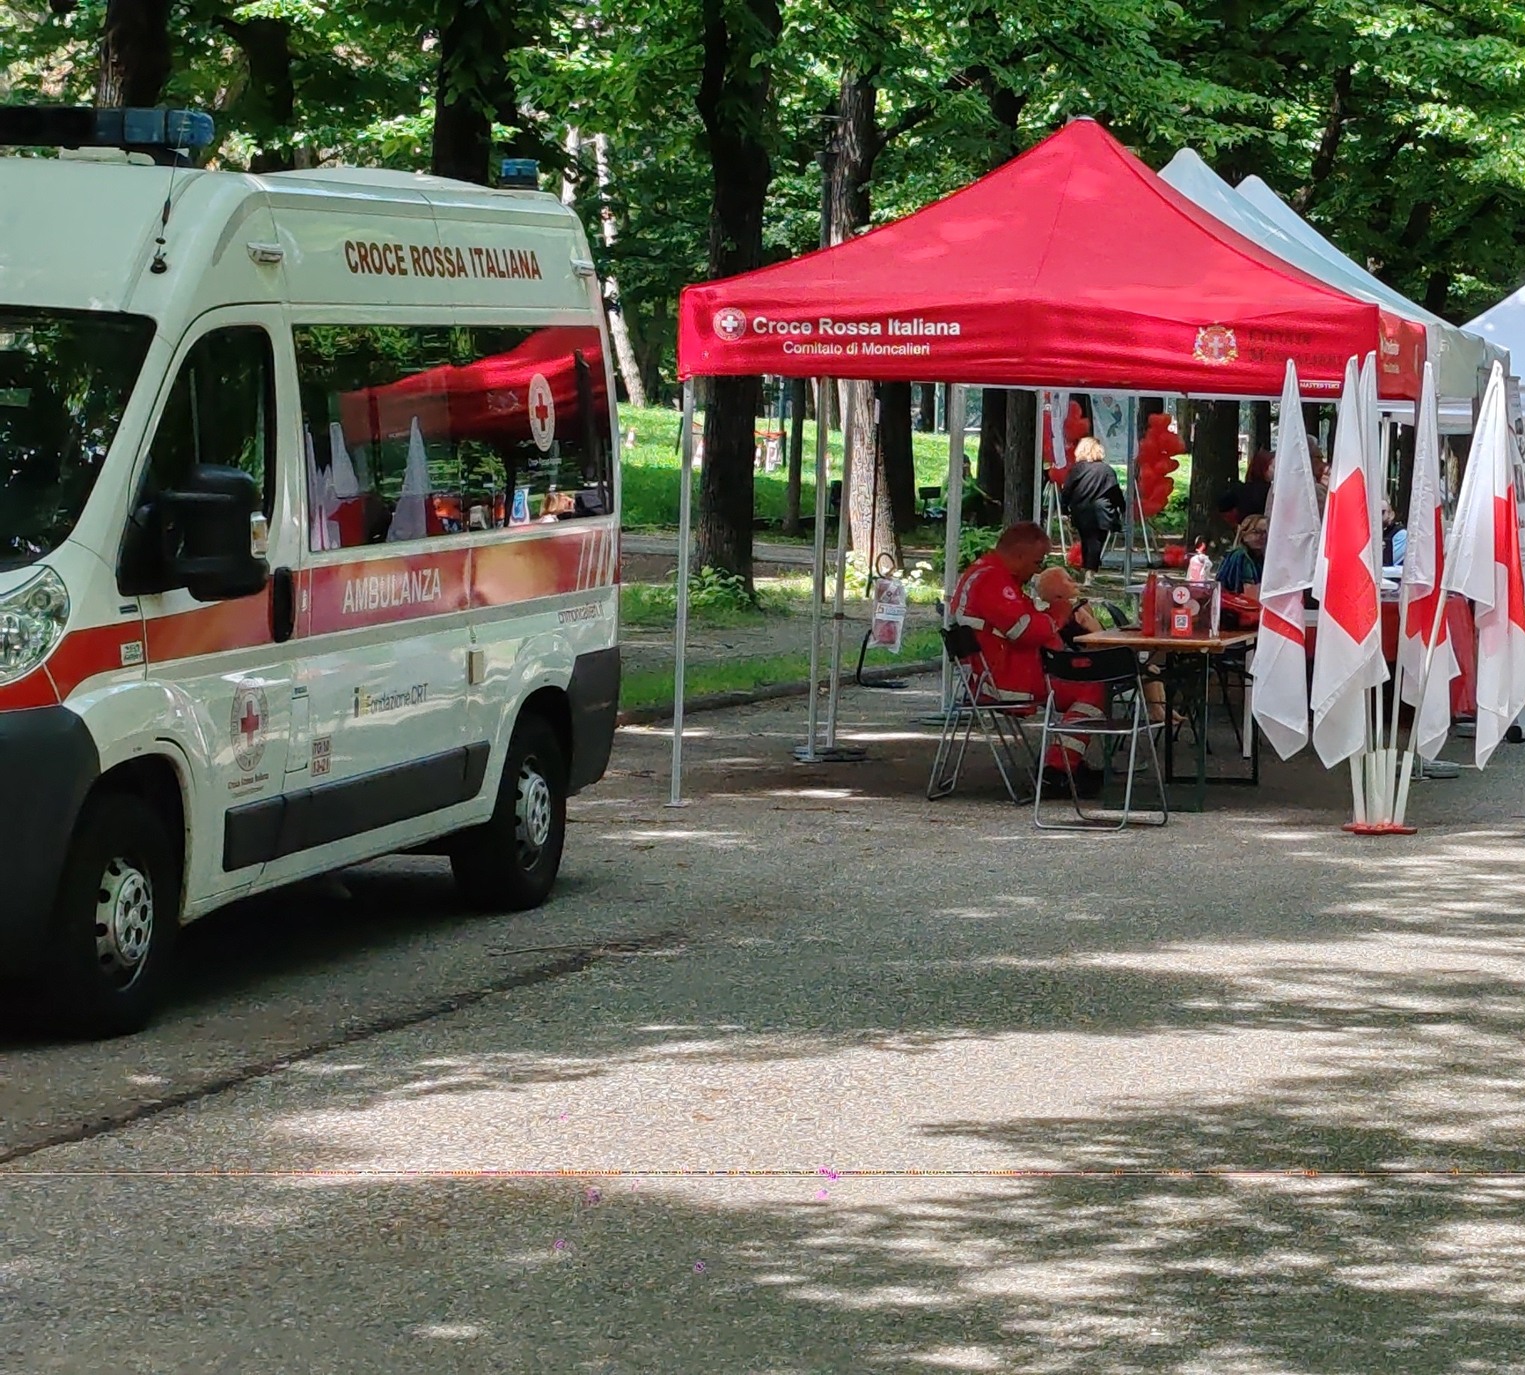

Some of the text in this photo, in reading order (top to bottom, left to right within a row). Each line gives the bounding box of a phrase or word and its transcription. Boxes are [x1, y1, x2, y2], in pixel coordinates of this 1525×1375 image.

[344, 240, 543, 280] CROCE ROSSA ITALIANA
[752, 317, 961, 336] Croce Rossa Italiana
[783, 341, 931, 356] Comitato di Moncalieri
[342, 568, 442, 614] AMBULANZA
[411, 683, 429, 704] CRT
